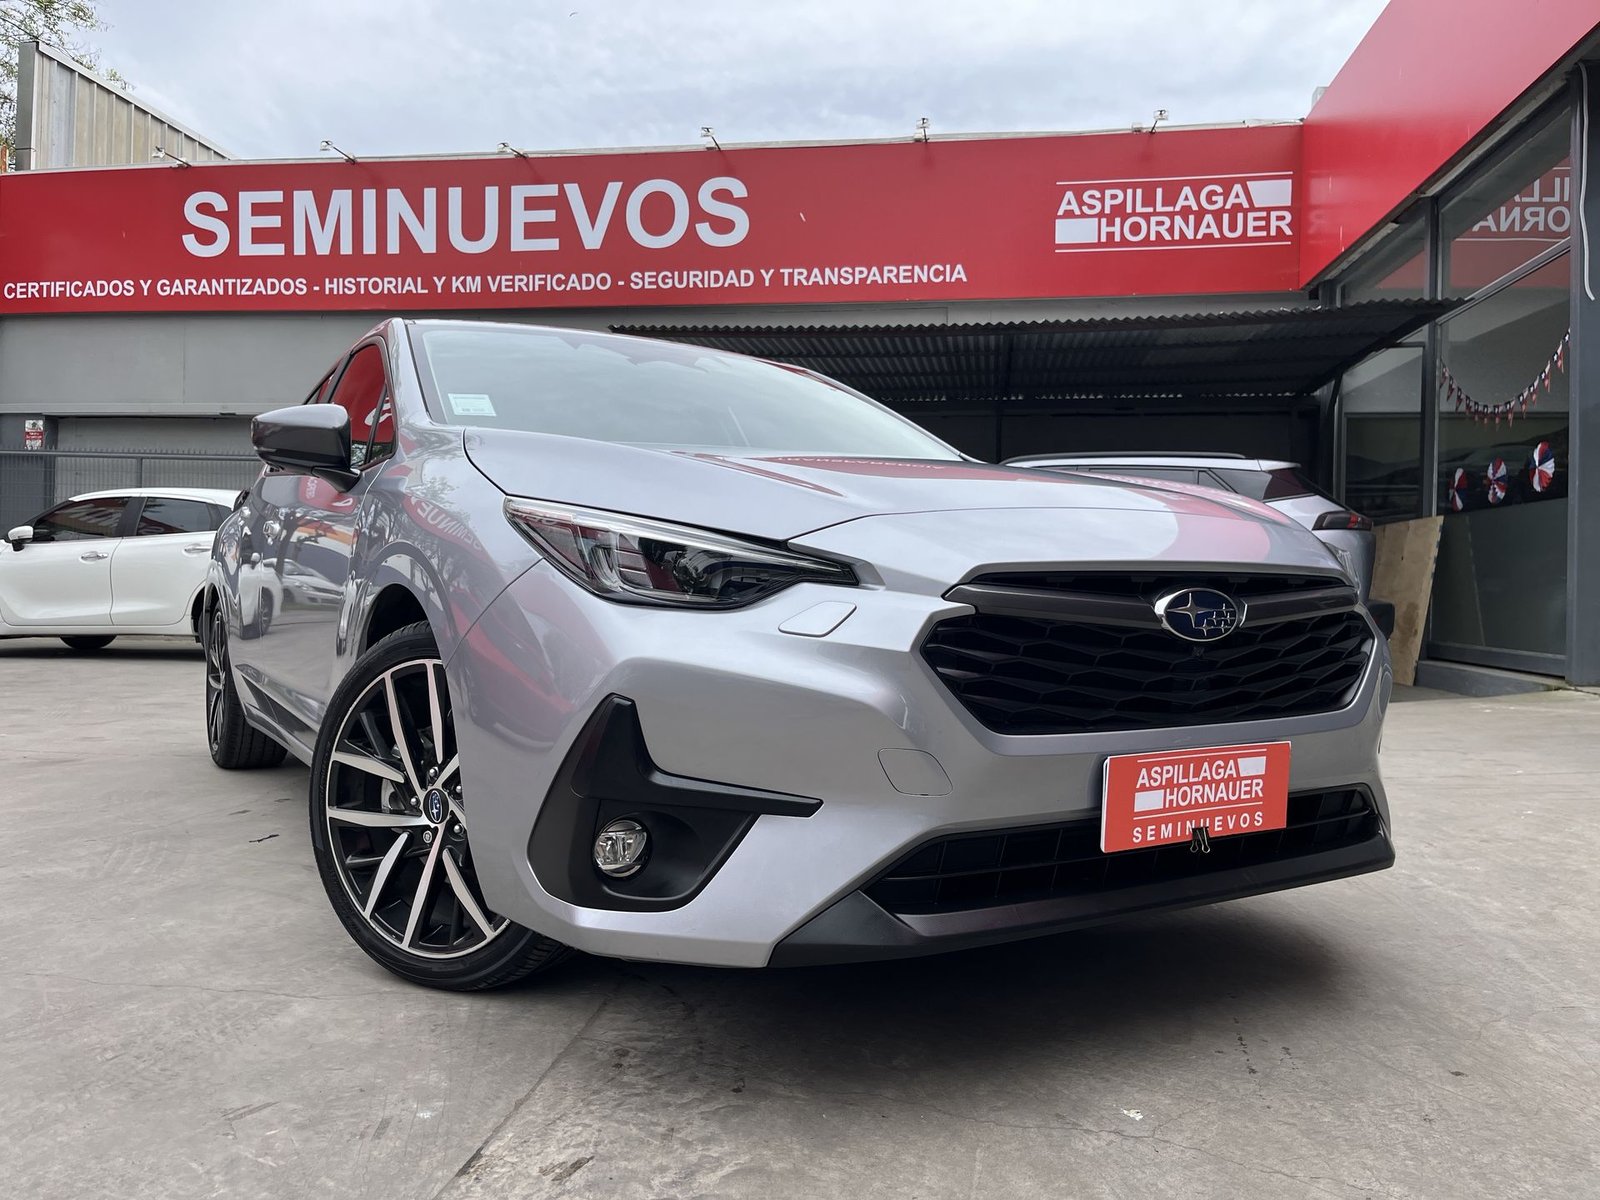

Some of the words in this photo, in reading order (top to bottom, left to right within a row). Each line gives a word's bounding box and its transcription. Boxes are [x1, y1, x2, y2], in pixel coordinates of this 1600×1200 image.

[1056, 183, 1250, 216] ASPILLAGA
[182, 177, 749, 257] SEMINUEVOS
[1101, 210, 1293, 243] HORNAUER
[3, 279, 135, 299] CERTIFICADOS
[140, 280, 152, 296] Y
[156, 277, 307, 297] GARANTIZADOS
[325, 276, 428, 295] HISTORIAL
[433, 276, 446, 293] Y
[451, 275, 482, 293] KM
[487, 272, 612, 293] VERIFICADO
[629, 269, 754, 290] SEGURIDAD
[759, 269, 775, 287] Y
[779, 263, 968, 287] TRANSPARENCIA
[1136, 759, 1237, 789] ASPILLAGA
[1165, 778, 1263, 809] HORNAUER
